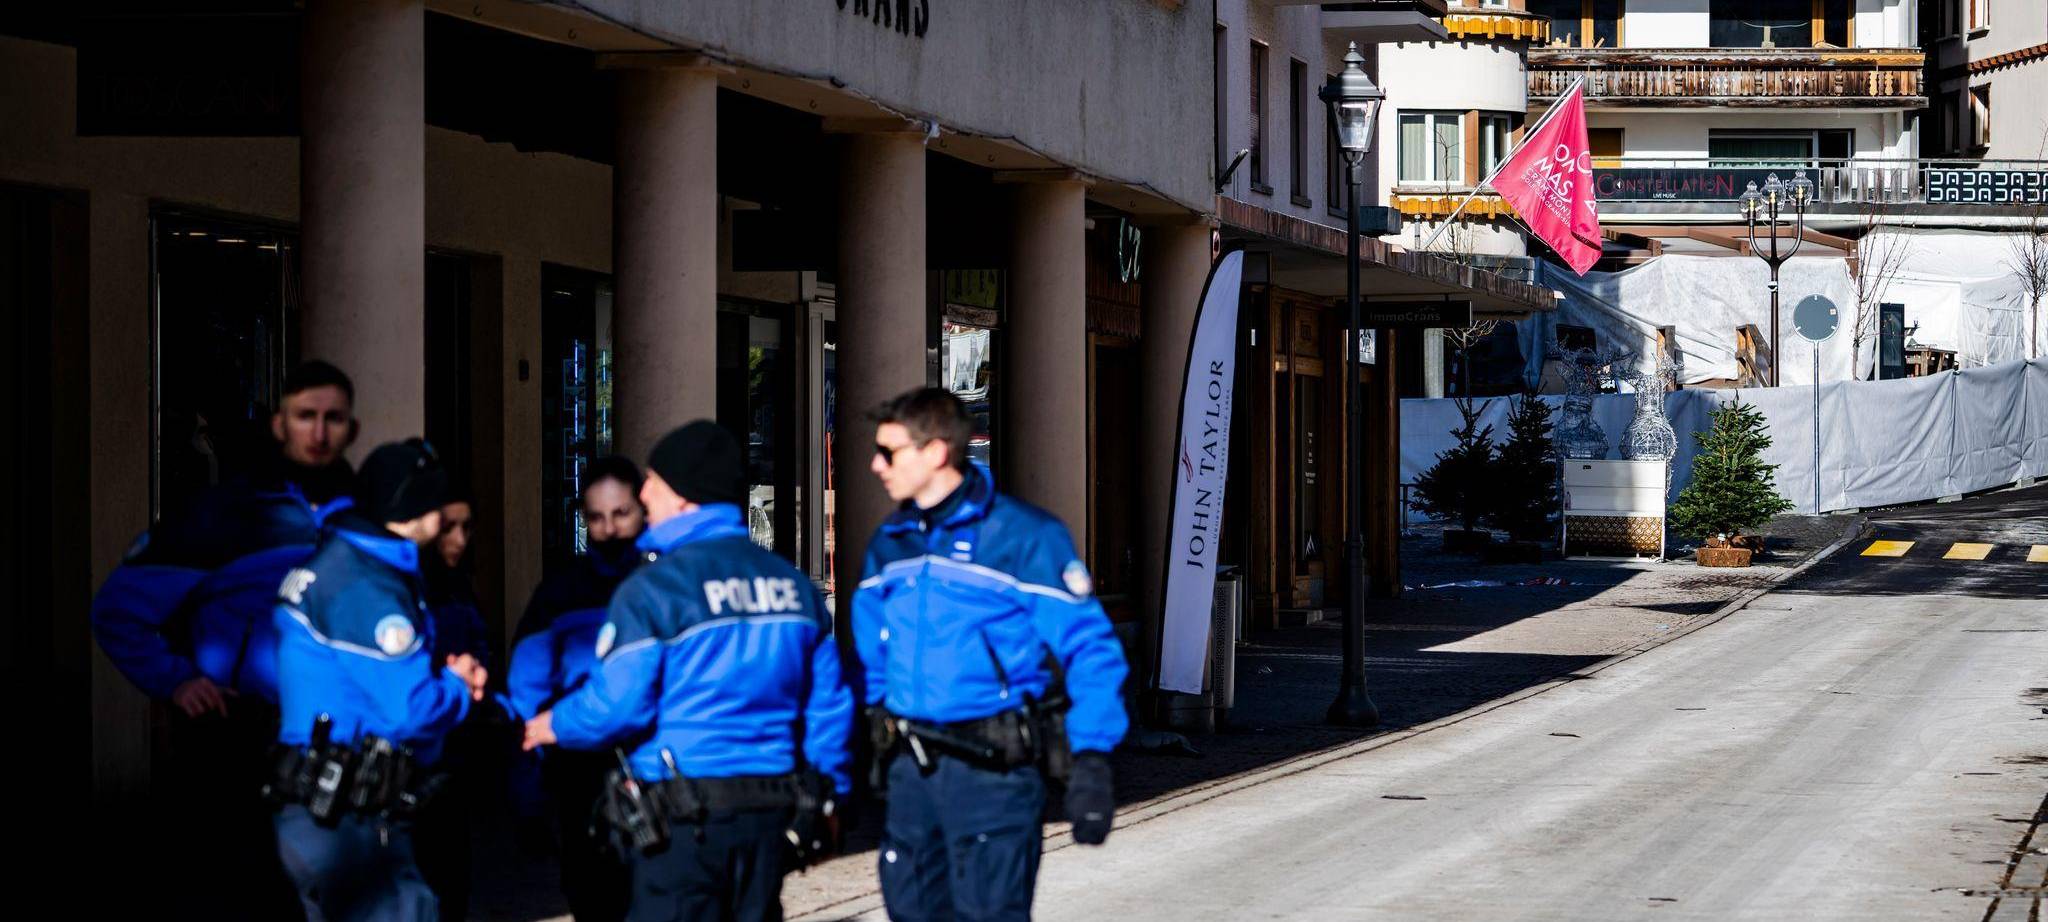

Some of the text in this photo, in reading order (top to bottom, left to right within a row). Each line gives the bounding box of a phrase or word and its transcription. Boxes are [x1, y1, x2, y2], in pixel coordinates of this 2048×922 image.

[1186, 359, 1225, 569] JOHN TAYLOR
[703, 576, 803, 616] POLICE
